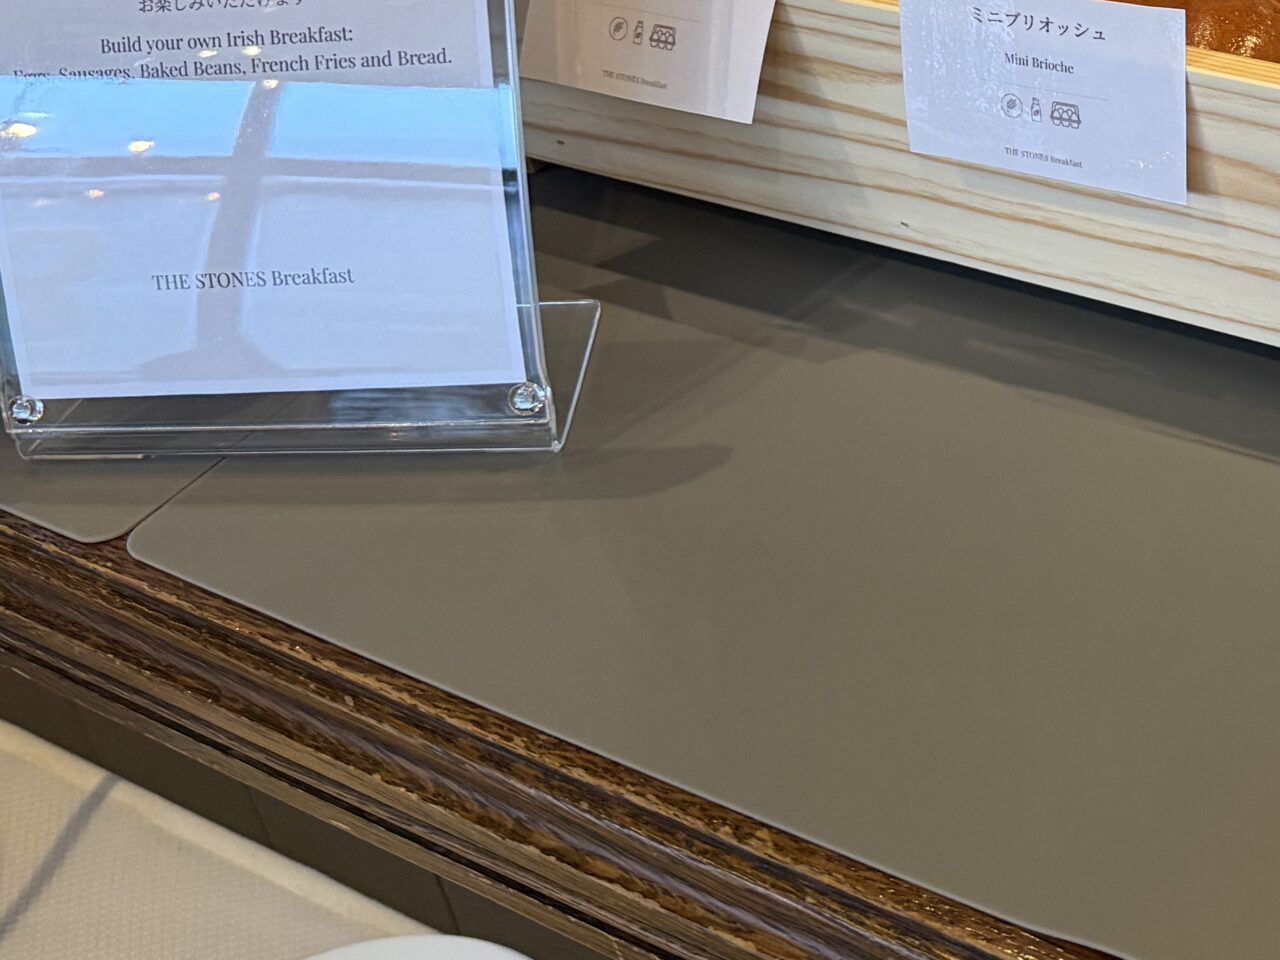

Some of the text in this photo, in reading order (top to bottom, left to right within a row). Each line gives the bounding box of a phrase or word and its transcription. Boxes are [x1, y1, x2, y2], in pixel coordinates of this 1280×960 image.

[971, 5, 1106, 41] ミニブリオッシュ
[100, 25, 354, 57] Build your own Irish Breakfast:
[140, 61, 189, 80] Baked
[251, 54, 310, 74] French
[315, 52, 357, 71] Fries
[361, 50, 393, 69] and
[398, 47, 453, 67] Bread.
[1004, 52, 1075, 75] Mini Brioche
[1004, 146, 1083, 169] THE STONES Breakfast
[151, 266, 356, 291] THE STONES Breakfast
